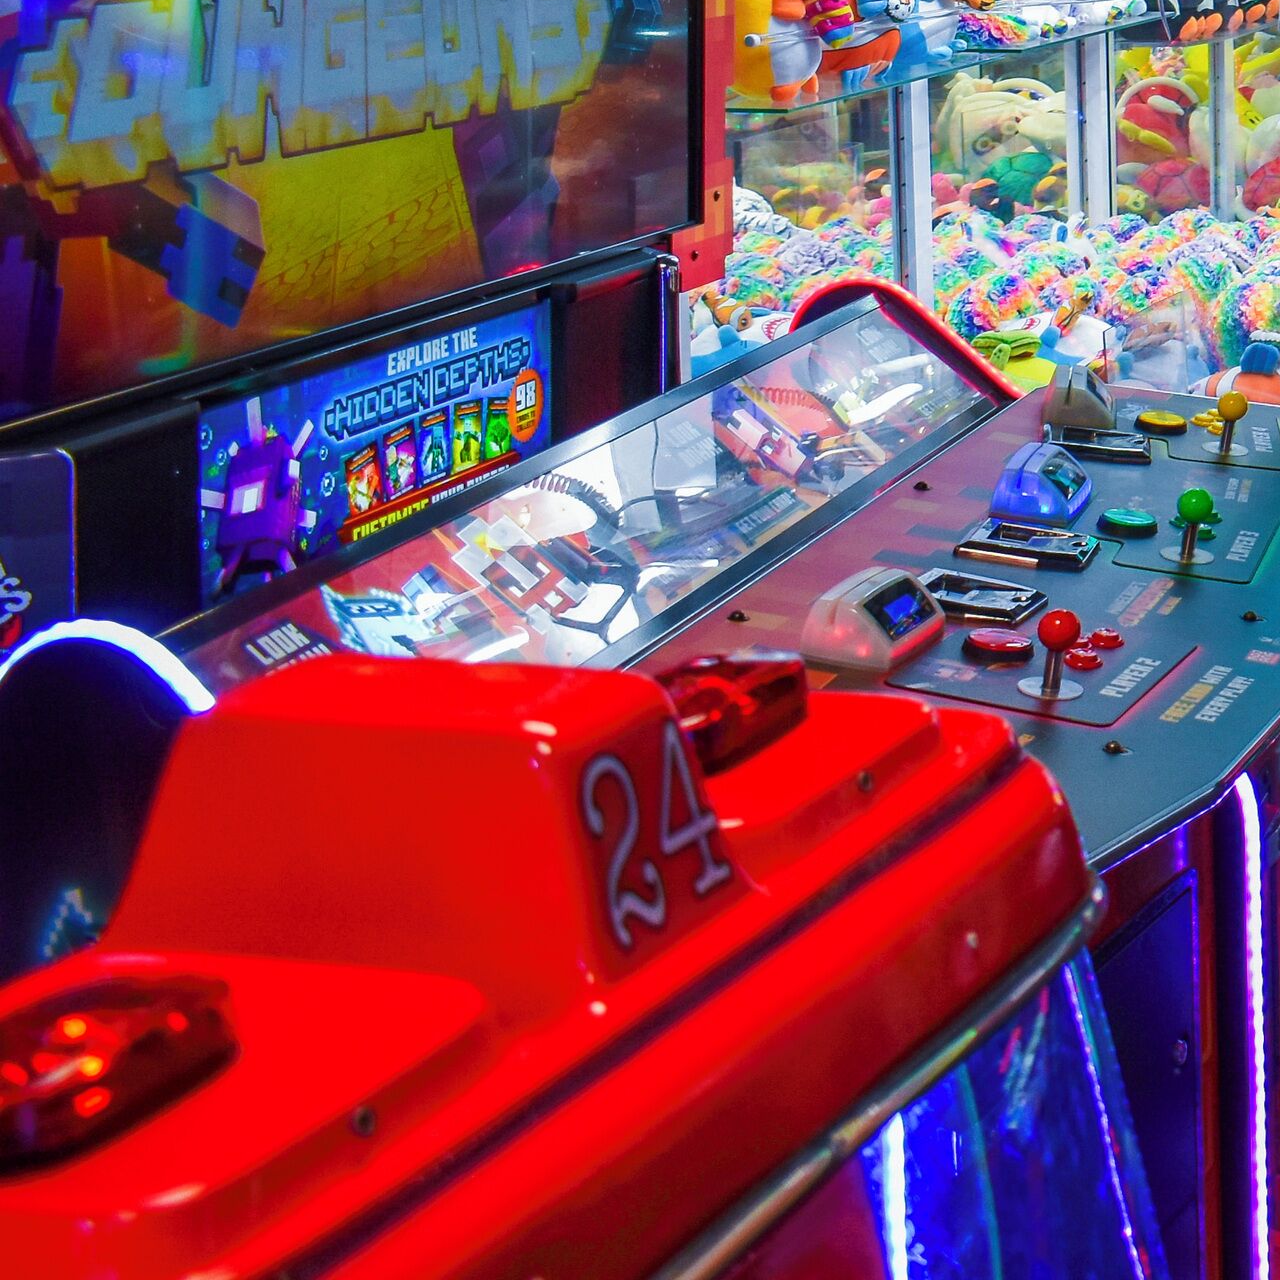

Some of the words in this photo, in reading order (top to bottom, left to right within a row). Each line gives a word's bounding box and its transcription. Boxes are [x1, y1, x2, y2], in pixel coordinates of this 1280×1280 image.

[387, 335, 450, 376] EXPLORE
[453, 326, 479, 354] THE
[335, 371, 430, 431] HIDDEN
[433, 342, 524, 406] DEPTHS
[516, 379, 536, 412] 98
[1226, 537, 1257, 562] PLAYER
[247, 622, 310, 666] LOOK
[1099, 661, 1153, 698] PLAYER
[1159, 696, 1197, 724] FREE
[1199, 664, 1234, 686] WITH
[1194, 690, 1235, 723] EVERY
[1218, 674, 1256, 701] PLAY!
[581, 719, 735, 948] 24
